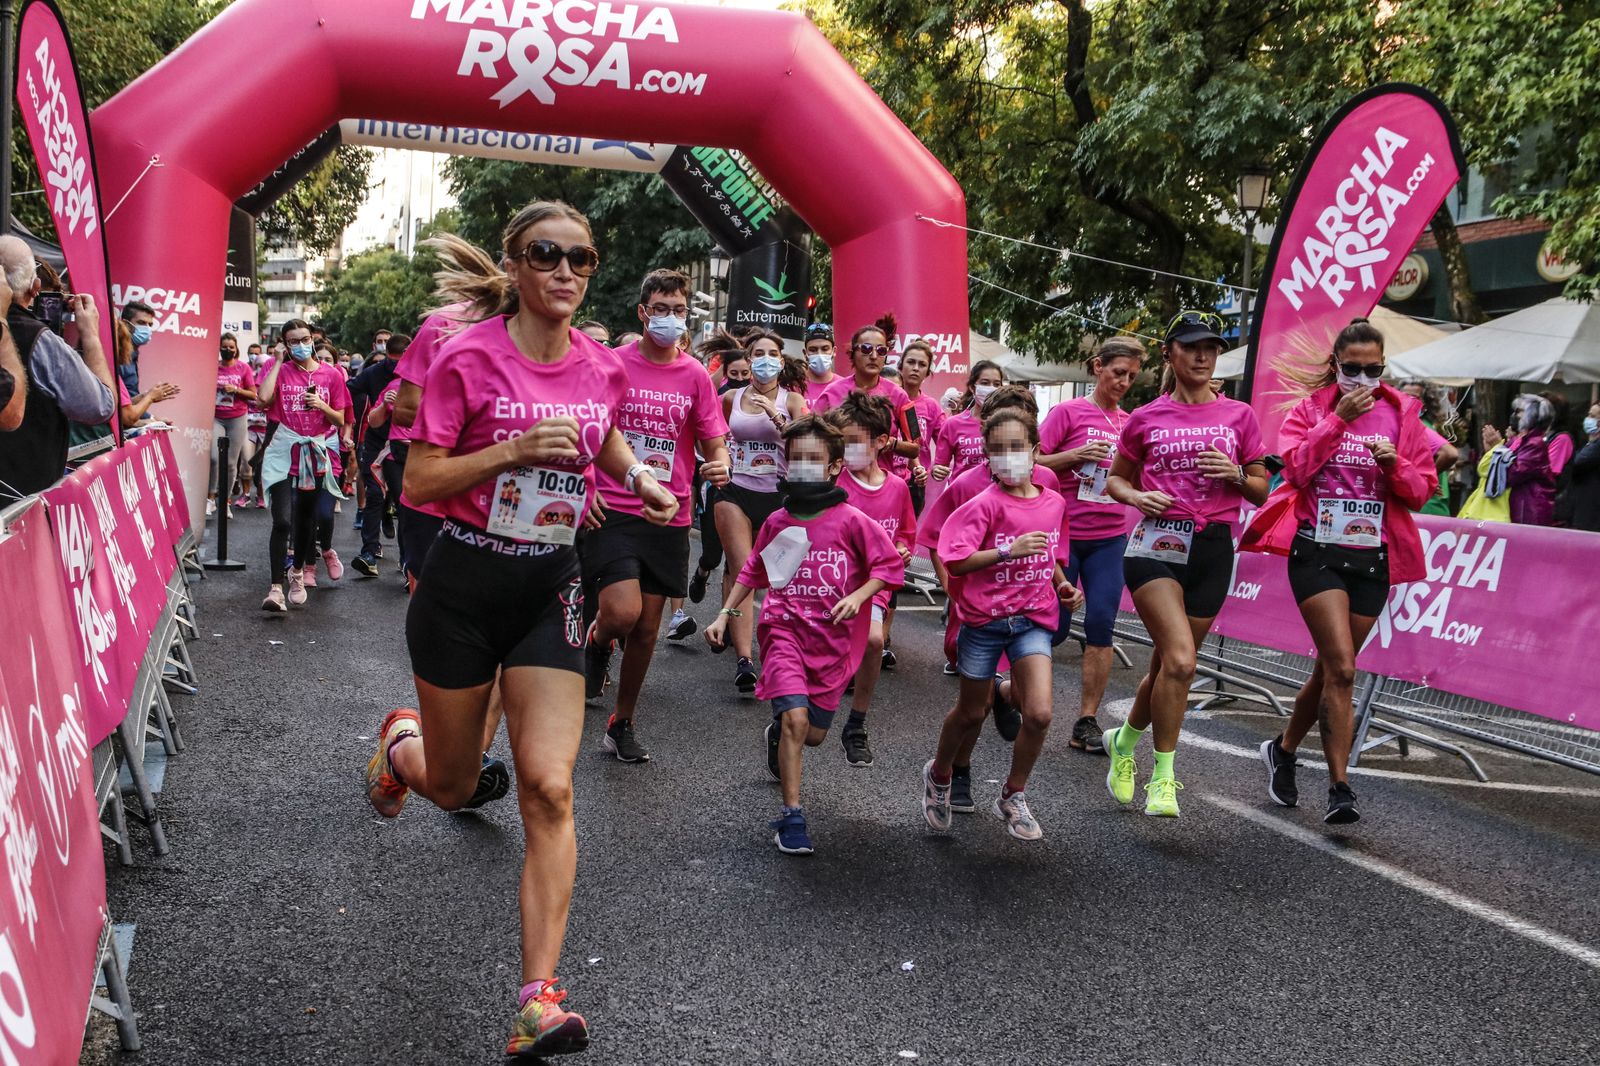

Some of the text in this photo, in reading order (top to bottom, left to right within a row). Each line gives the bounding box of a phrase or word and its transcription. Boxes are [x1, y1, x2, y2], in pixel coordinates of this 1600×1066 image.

[410, 0, 679, 43] MARCHA
[1277, 126, 1409, 311] MARCHA
[736, 310, 807, 327] Extremadura
[494, 397, 526, 419] En
[1150, 429, 1169, 442] En
[644, 436, 675, 453] 10:00
[748, 442, 777, 451] 10:00
[1152, 439, 1206, 457] contra
[538, 470, 586, 496] 10:00
[1342, 500, 1381, 515] 10:00
[516, 545, 555, 557] FILA
[995, 567, 1010, 583] el
